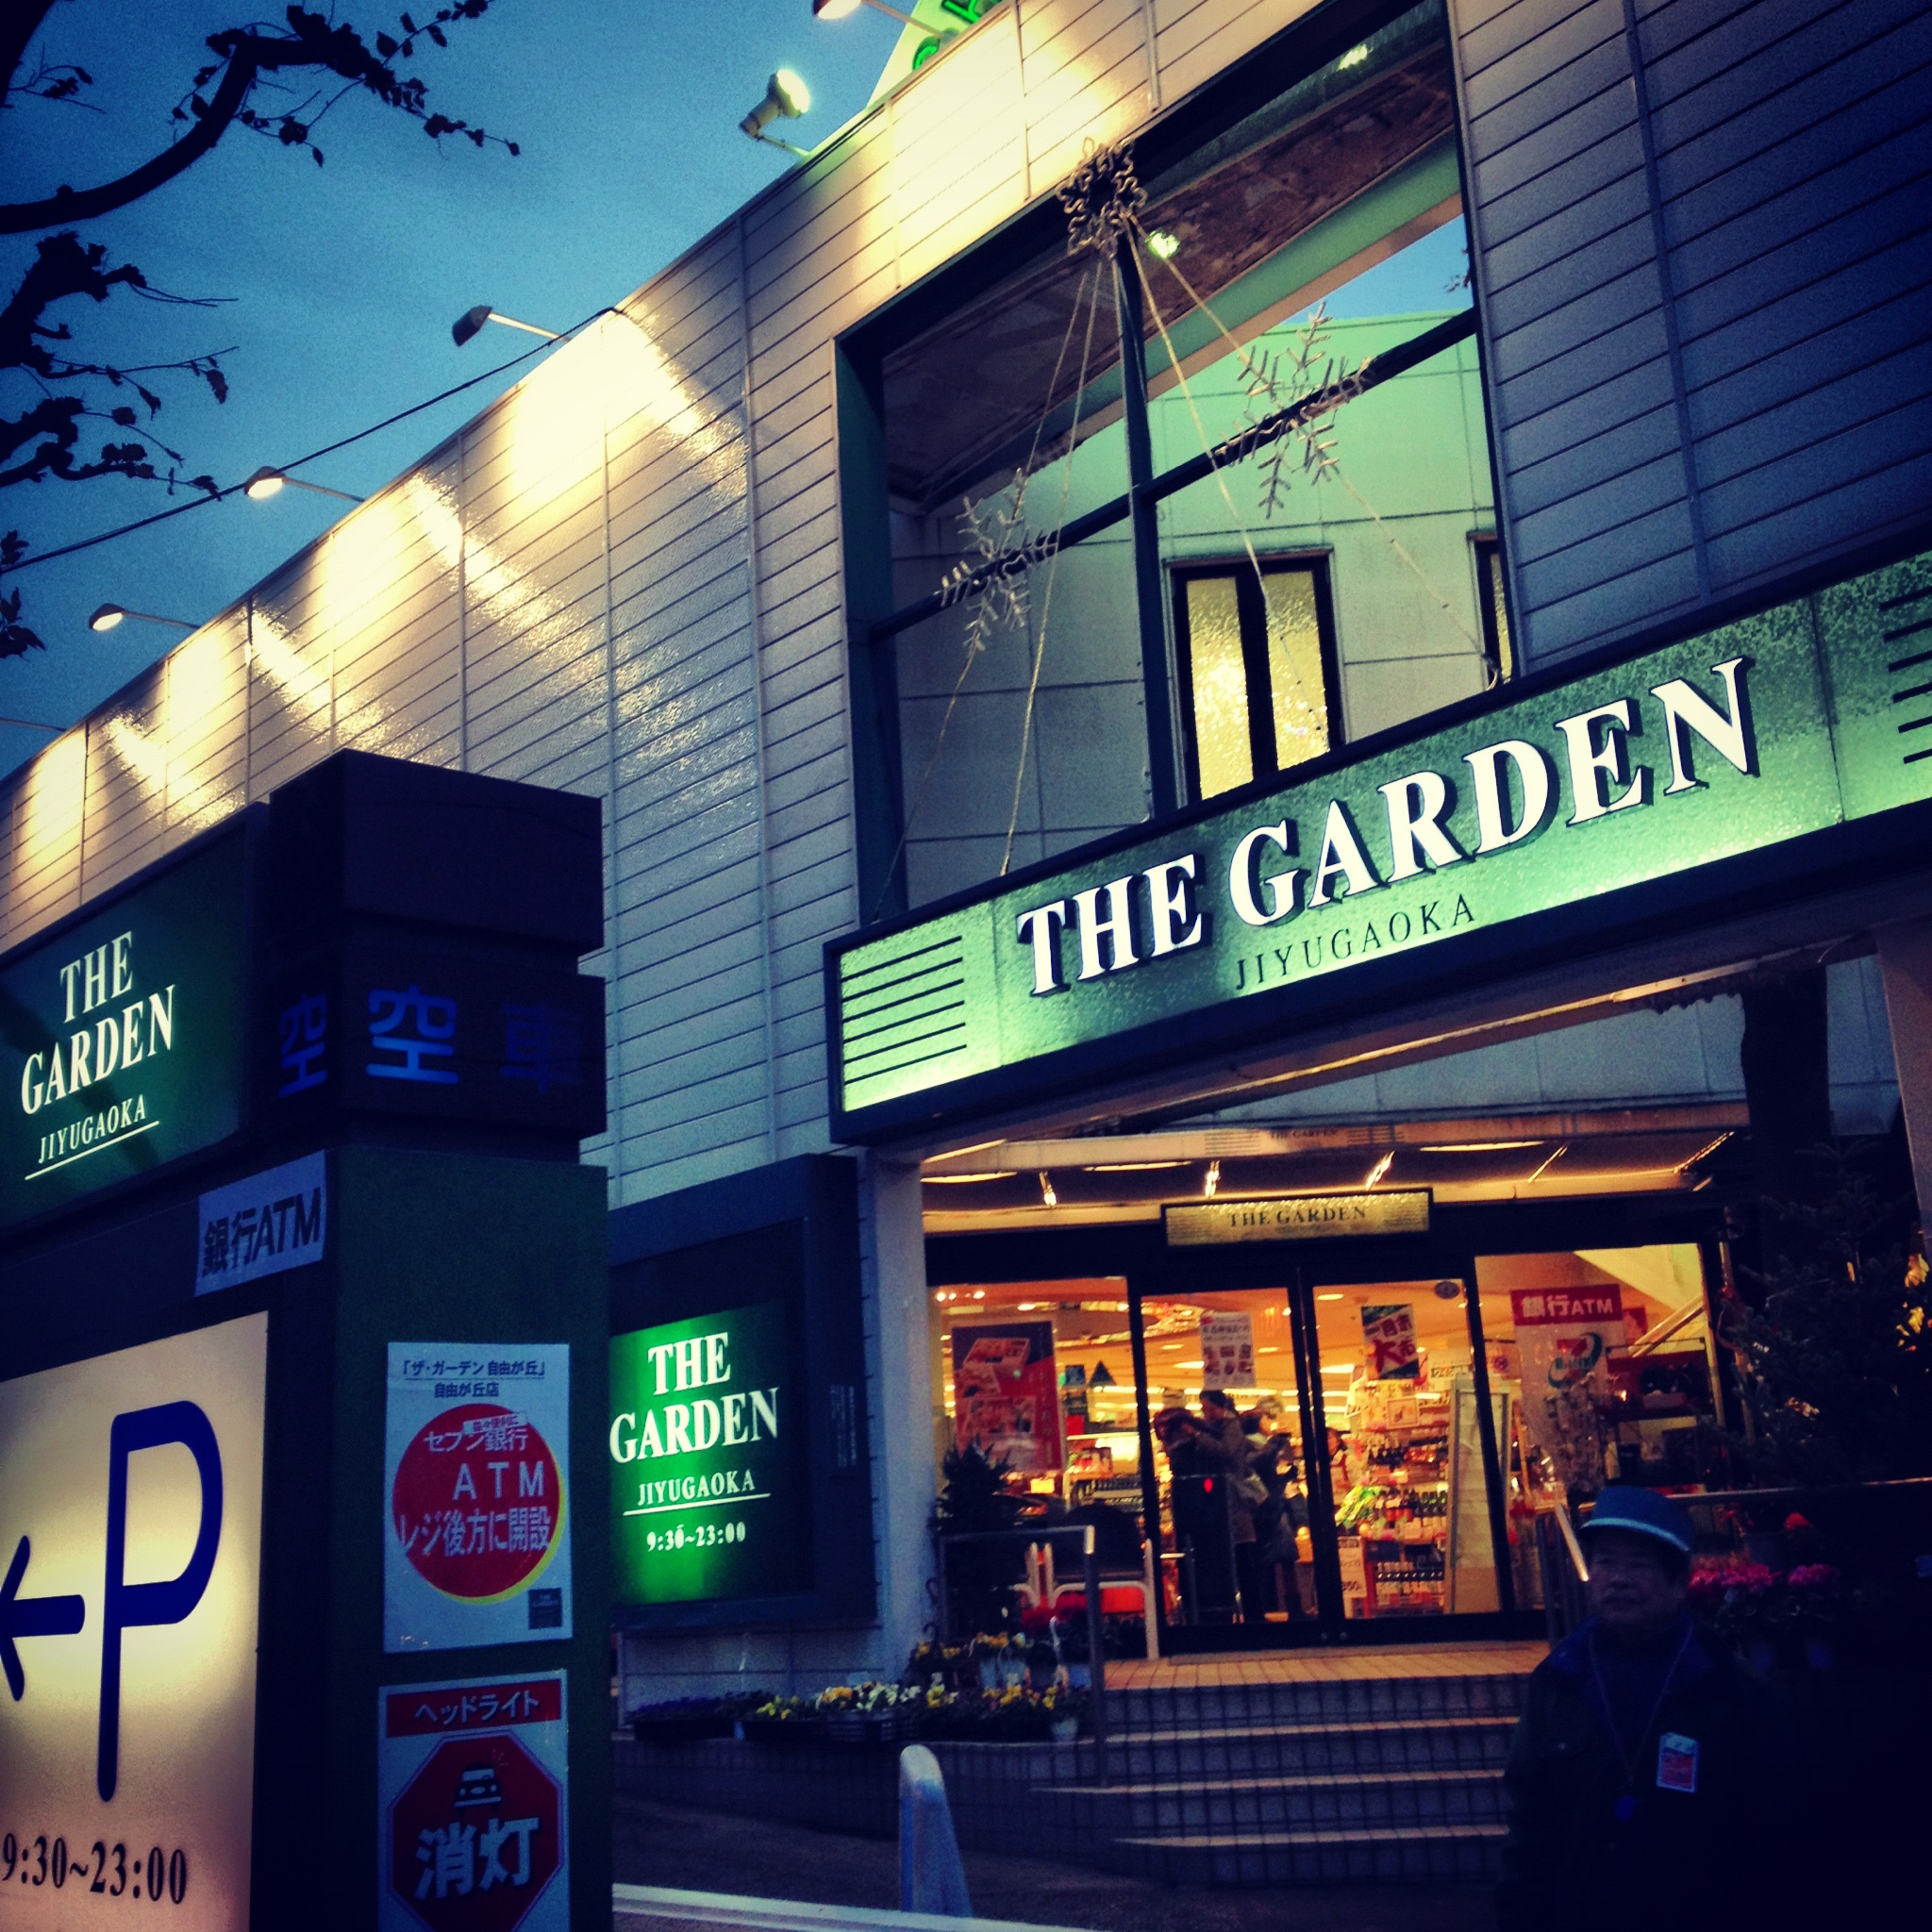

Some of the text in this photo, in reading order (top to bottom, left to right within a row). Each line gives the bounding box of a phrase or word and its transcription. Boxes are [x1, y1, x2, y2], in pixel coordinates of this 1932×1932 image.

[1016, 656, 1758, 997] THE GARDEN
[60, 930, 133, 1024] THE
[1236, 892, 1476, 991] JIYUGAOKA
[21, 984, 176, 1115] GARDEN
[38, 1094, 147, 1164] JIYUGAOKA
[201, 1186, 322, 1278] 銀行ATM
[1228, 1206, 1367, 1227] THE GARDEN
[1522, 1294, 1614, 1318] 銀行ATM
[434, 1382, 500, 1399] 自由が丘店
[647, 1332, 731, 1396] THE
[609, 1387, 779, 1463] GARDEN
[638, 1469, 756, 1507] JIYUGAOKA
[399, 1506, 551, 1557] レジ後方に開設
[97, 1400, 224, 1803] P
[414, 1690, 541, 1725] ヘッドライト
[413, 1817, 543, 1901] 消灯
